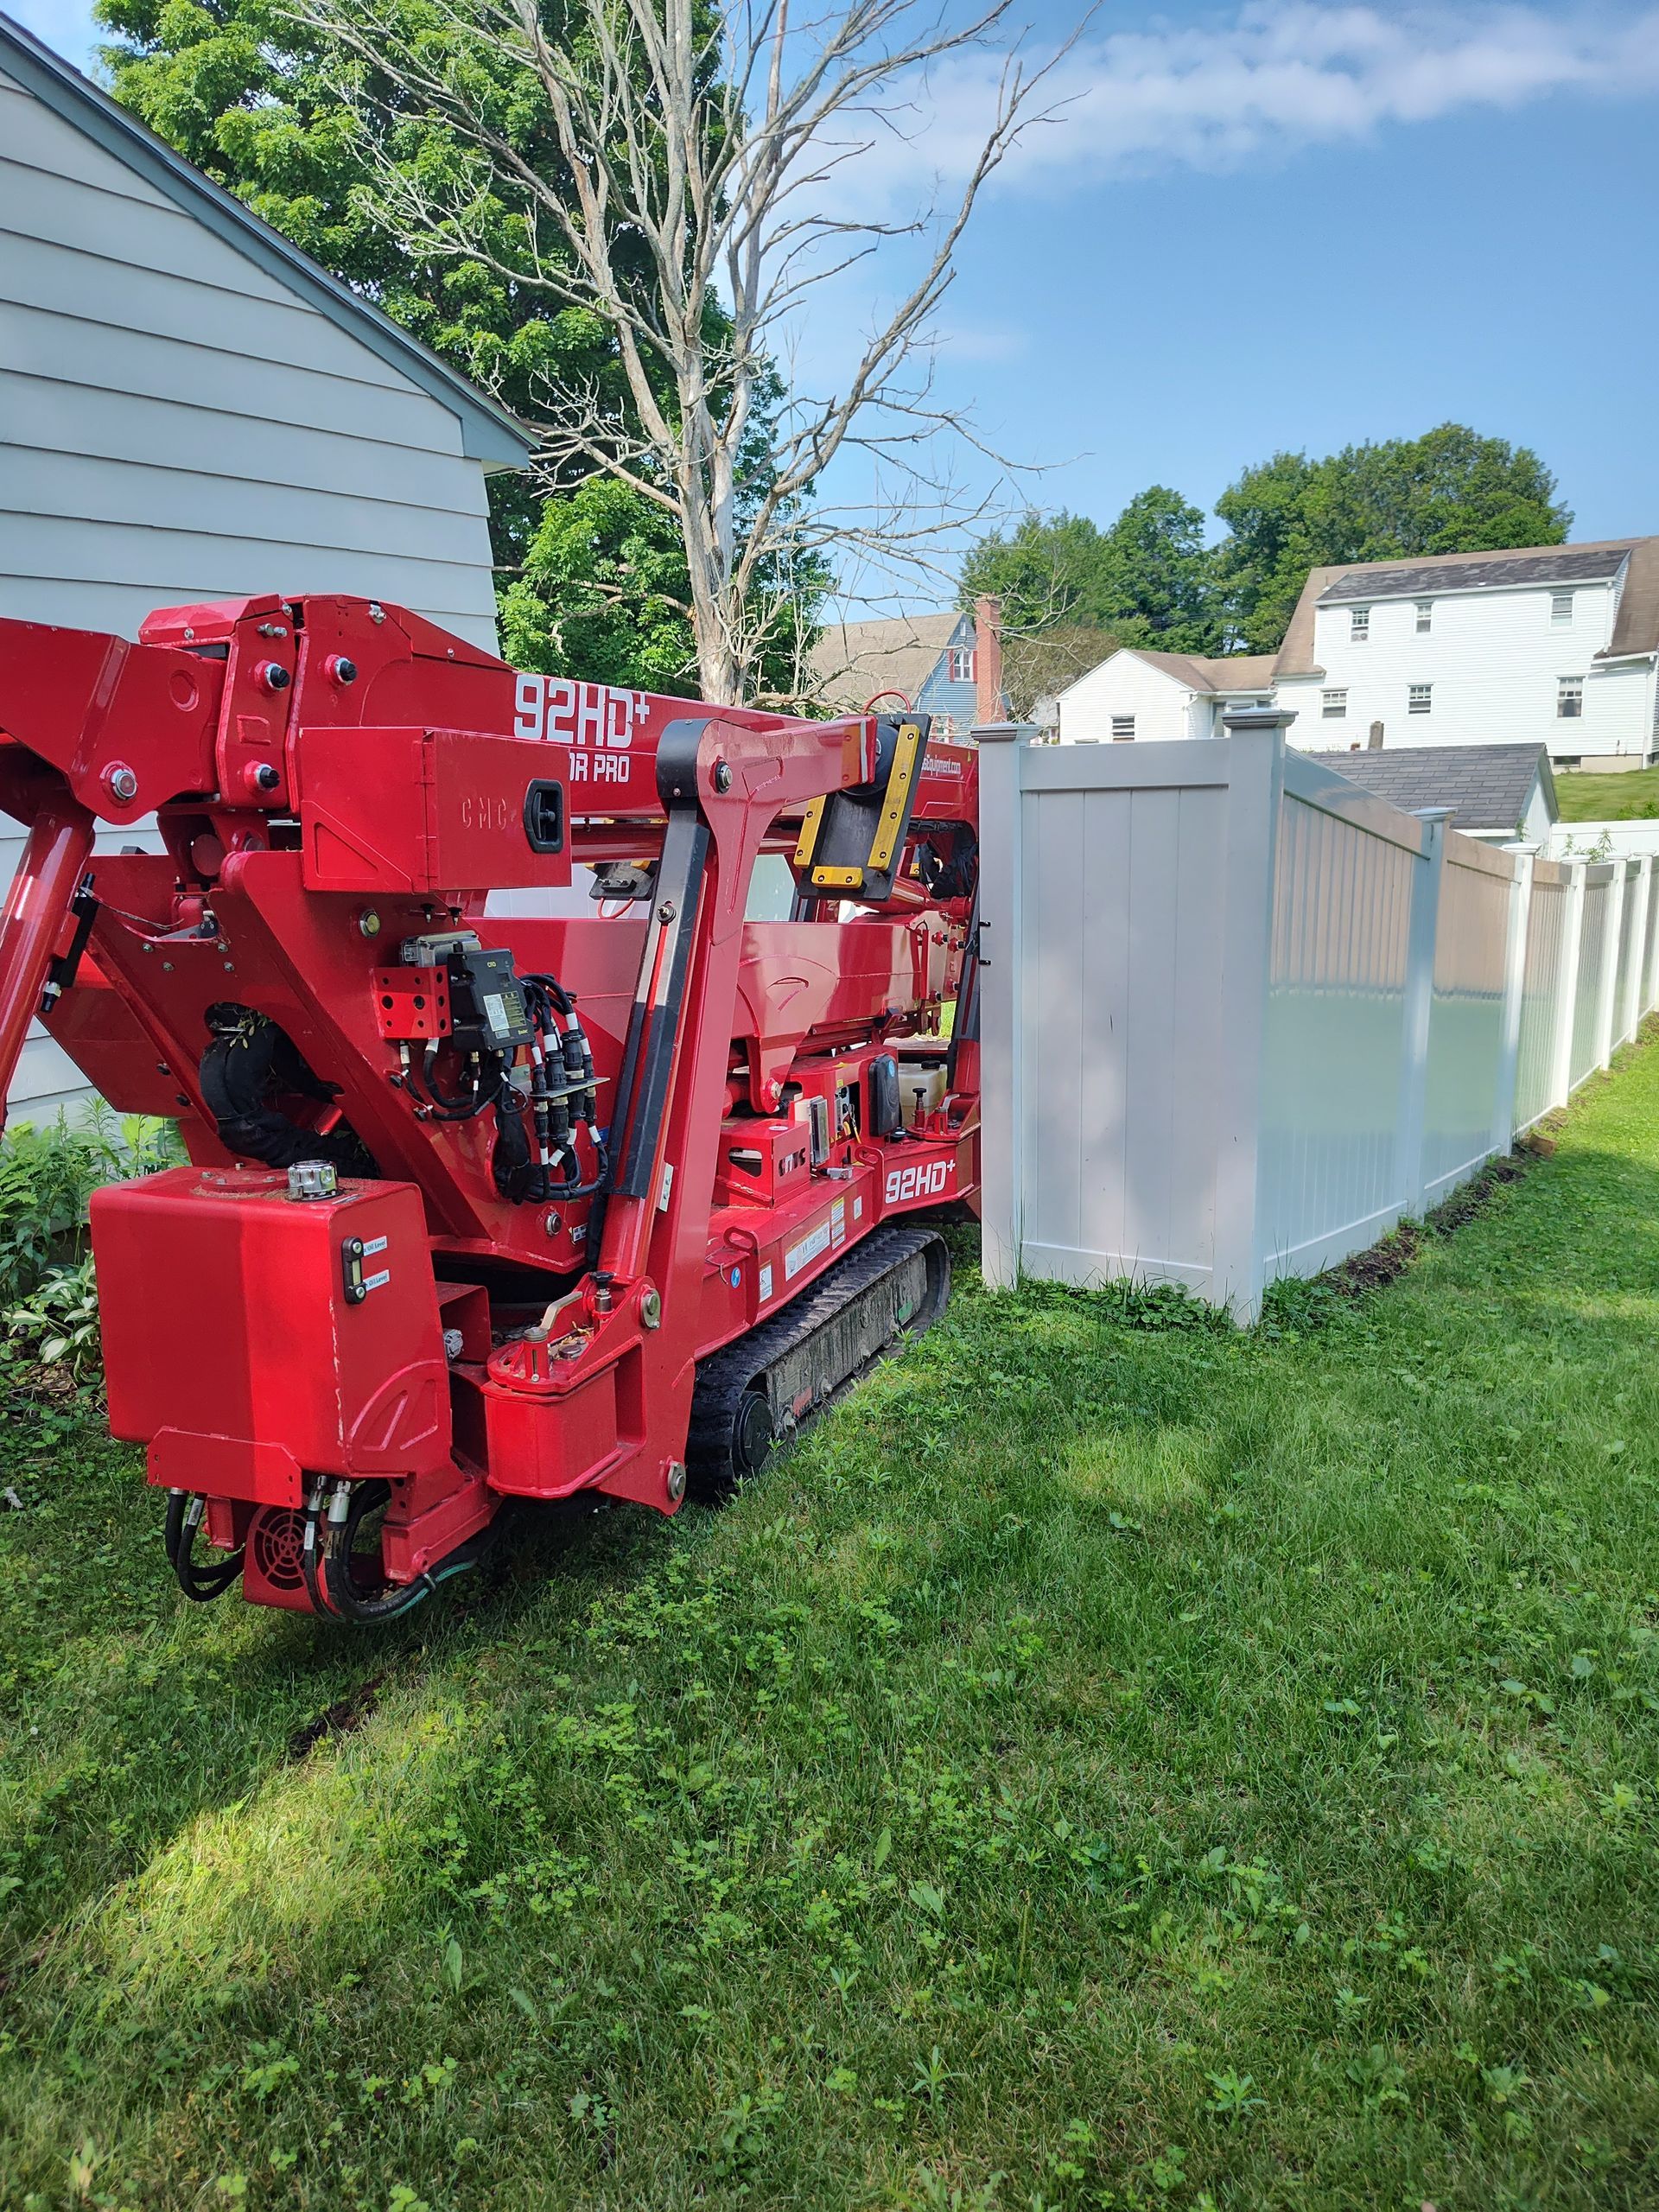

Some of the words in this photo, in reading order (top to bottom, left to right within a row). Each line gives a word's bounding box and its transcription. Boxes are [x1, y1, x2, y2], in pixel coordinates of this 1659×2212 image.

[514, 674, 650, 748] 92HD+
[594, 753, 630, 783] PRO
[885, 1159, 956, 1204] 92HD+
